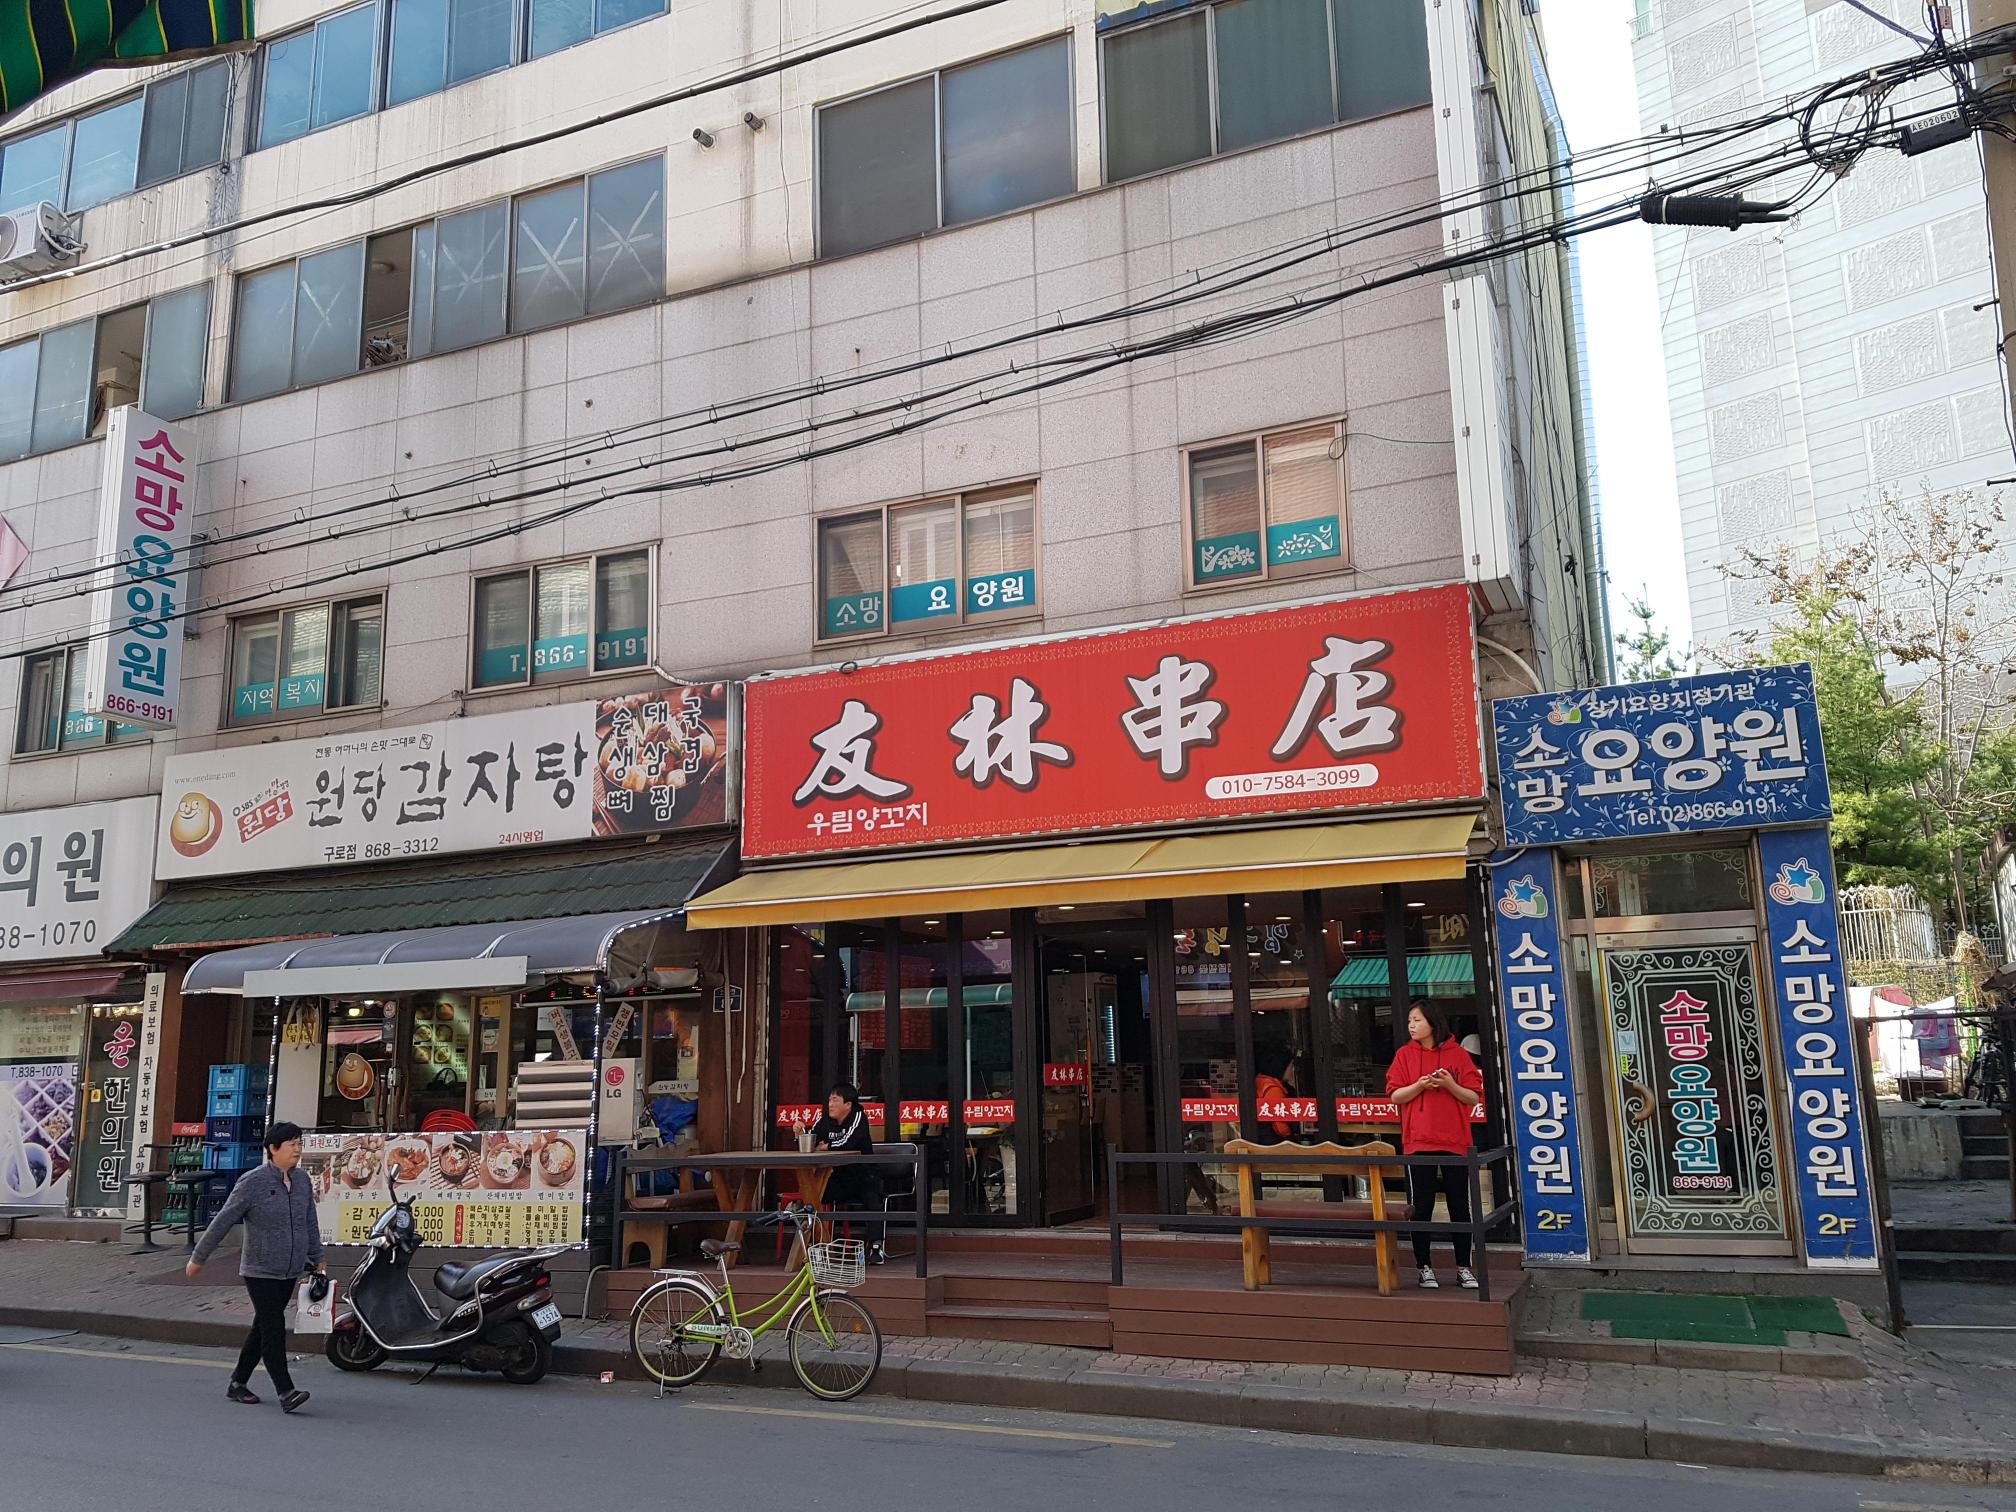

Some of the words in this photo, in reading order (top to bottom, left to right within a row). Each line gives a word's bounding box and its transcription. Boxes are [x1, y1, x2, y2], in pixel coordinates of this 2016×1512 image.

[1911, 110, 1959, 132] AE020602
[836, 597, 881, 626] 소망
[106, 694, 174, 722] 866-9191
[241, 689, 274, 712] 지역
[286, 680, 320, 704] 복지
[1585, 682, 1756, 721] 장기요양지정기관
[795, 635, 1398, 803] 友林串店
[371, 739, 388, 752] 손맛
[390, 736, 416, 748] 그대로
[1577, 707, 1807, 797] 요양원
[608, 738, 702, 782] 생삼겹
[1220, 768, 1362, 795] 010-7584-3099
[606, 784, 676, 822] 뼈찜
[806, 800, 930, 835] 우림양꼬치
[323, 844, 357, 862] 구로점
[364, 837, 439, 858] 868-3312
[498, 829, 545, 845] 24시영업
[146, 984, 160, 1045] 의료보험
[10, 1065, 63, 1079] T.838-1070
[1506, 931, 1575, 1195] 소망요양원
[1780, 919, 1858, 1198] 소망요양원
[138, 1056, 154, 1134] 자동차보험
[606, 1089, 622, 1098] LG
[1659, 989, 1721, 1174] 소망요양원
[900, 1104, 949, 1121] 友林串店
[963, 1103, 1014, 1119] 우림양꼬치
[1182, 1103, 1238, 1118] 우림양꼬치
[1258, 1103, 1317, 1119] 友林串店
[1337, 1103, 1398, 1118] 우림양꼬치
[97, 1077, 132, 1193] 한의원
[1672, 1175, 1733, 1190] 866-9191
[1537, 1210, 1572, 1230] 2F
[1817, 1213, 1857, 1235] 2F
